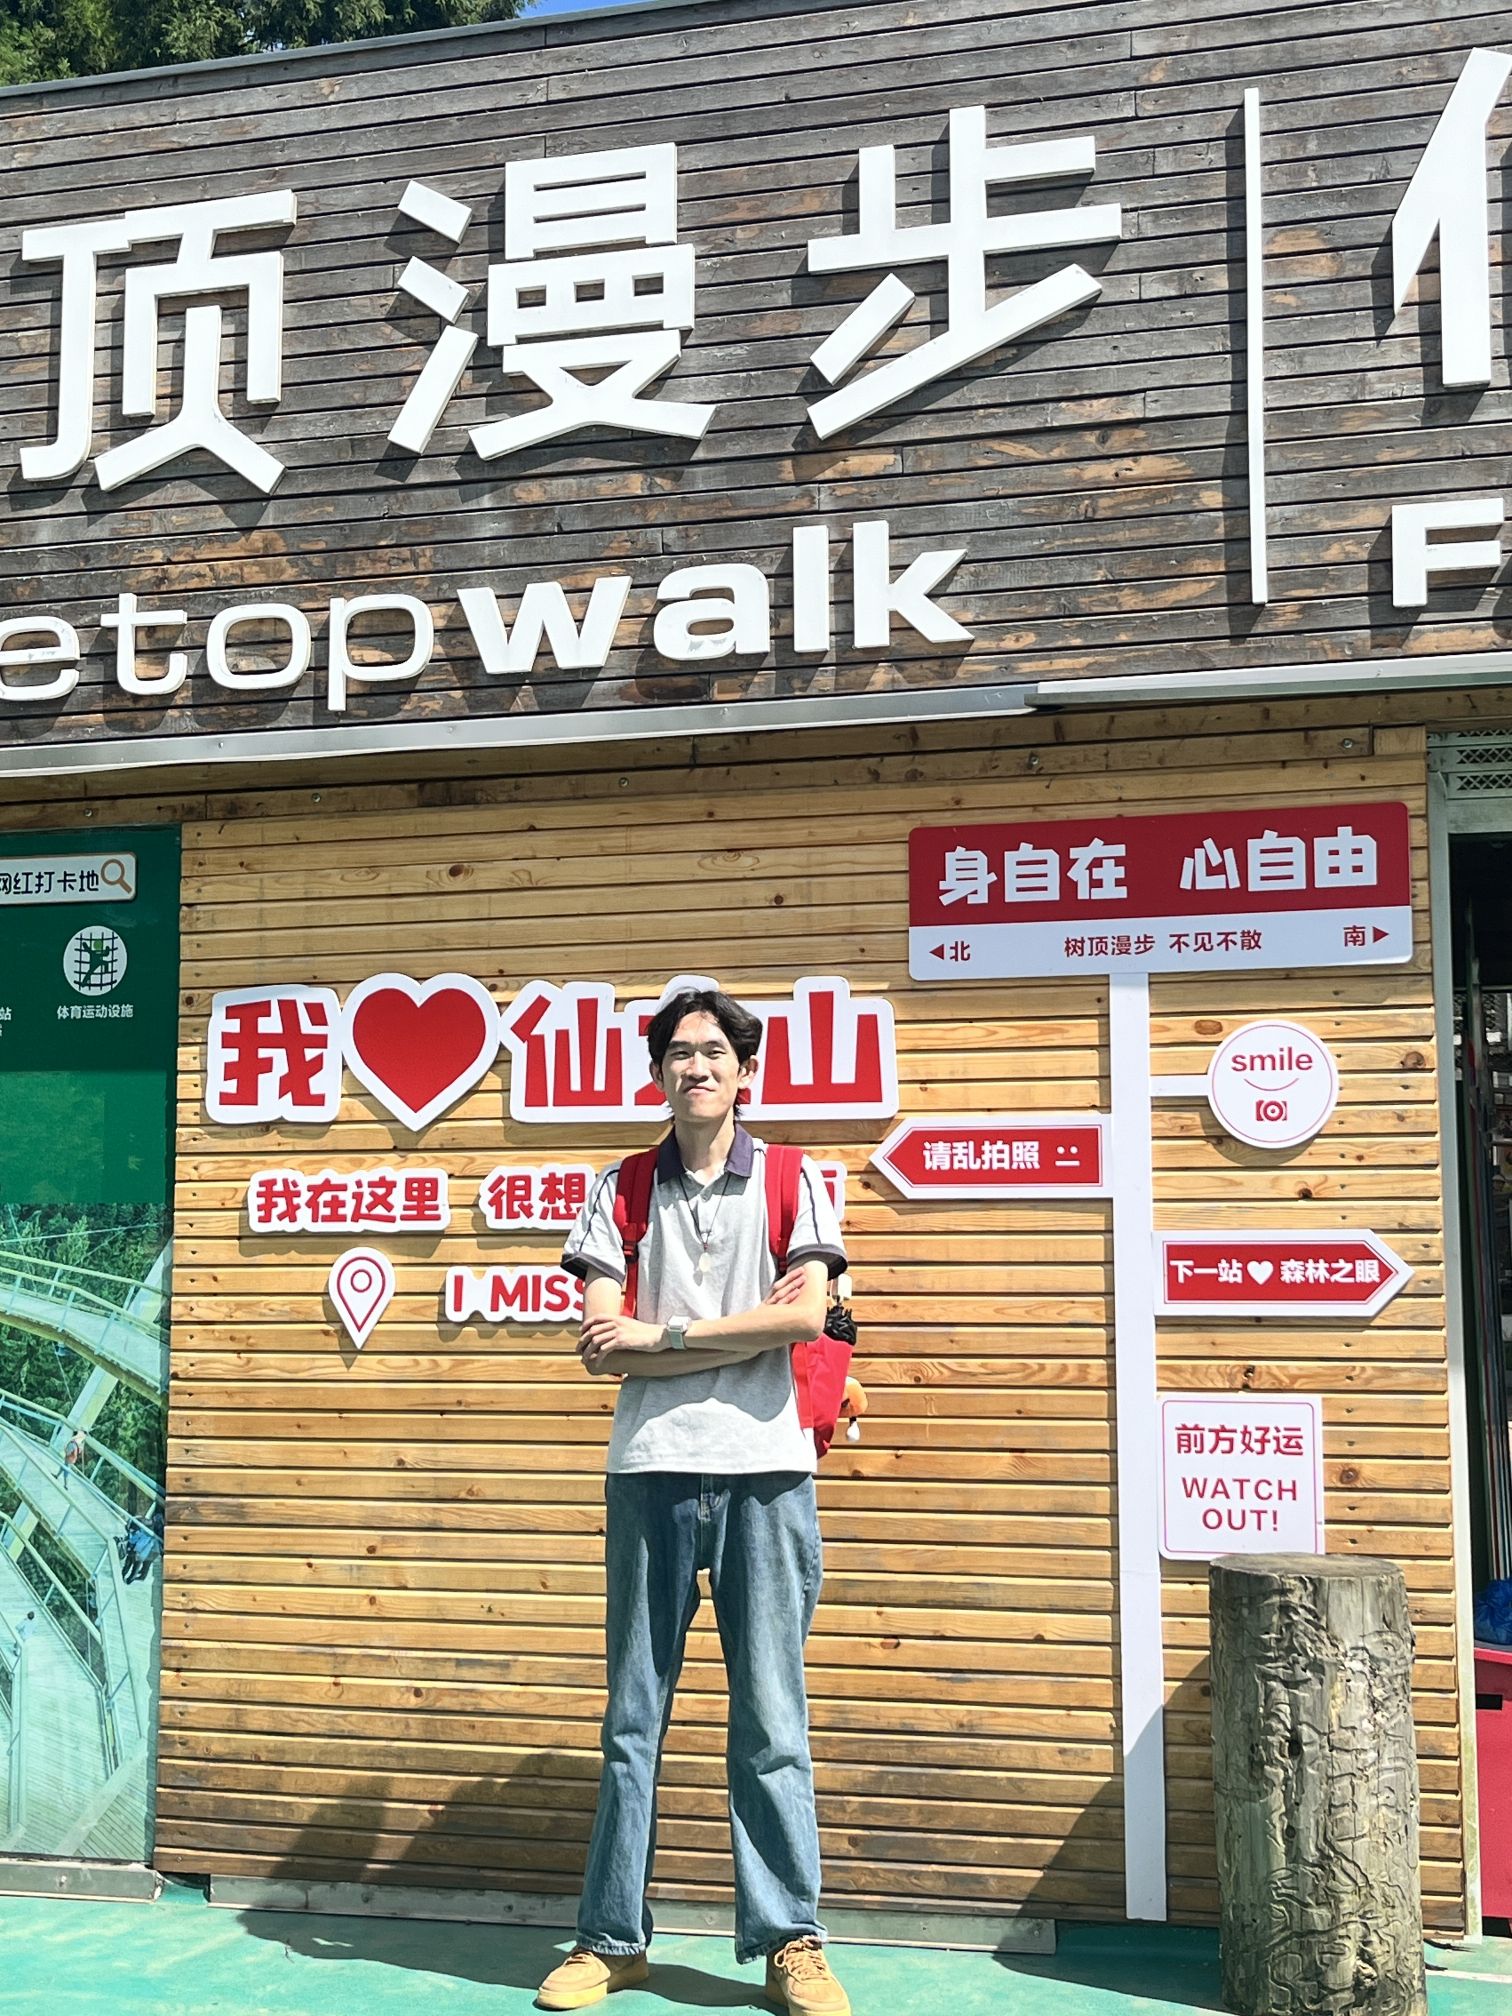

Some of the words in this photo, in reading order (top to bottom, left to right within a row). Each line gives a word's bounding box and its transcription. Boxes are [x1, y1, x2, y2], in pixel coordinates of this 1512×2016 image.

[938, 837, 1128, 907] 身自在
[1179, 826, 1379, 893] 心自由
[949, 940, 971, 963] 北
[1063, 935, 1156, 958] 树顶漫步
[1168, 928, 1263, 953] 不见不散
[1343, 925, 1367, 948] 南
[56, 1003, 134, 1020] 体育运动设施
[219, 998, 328, 1107] 我
[510, 990, 883, 1107] 仙山
[1231, 1046, 1314, 1073] smile
[923, 1140, 1040, 1171] 请乱拍照
[256, 1171, 442, 1223] 我在这里
[1169, 1258, 1243, 1285] 下一站
[1280, 1258, 1381, 1285] 森林之眼
[453, 1274, 464, 1313] I
[1175, 1423, 1305, 1457] 前方好运
[1181, 1476, 1298, 1502] WATCH
[1202, 1507, 1279, 1532] OUT!
